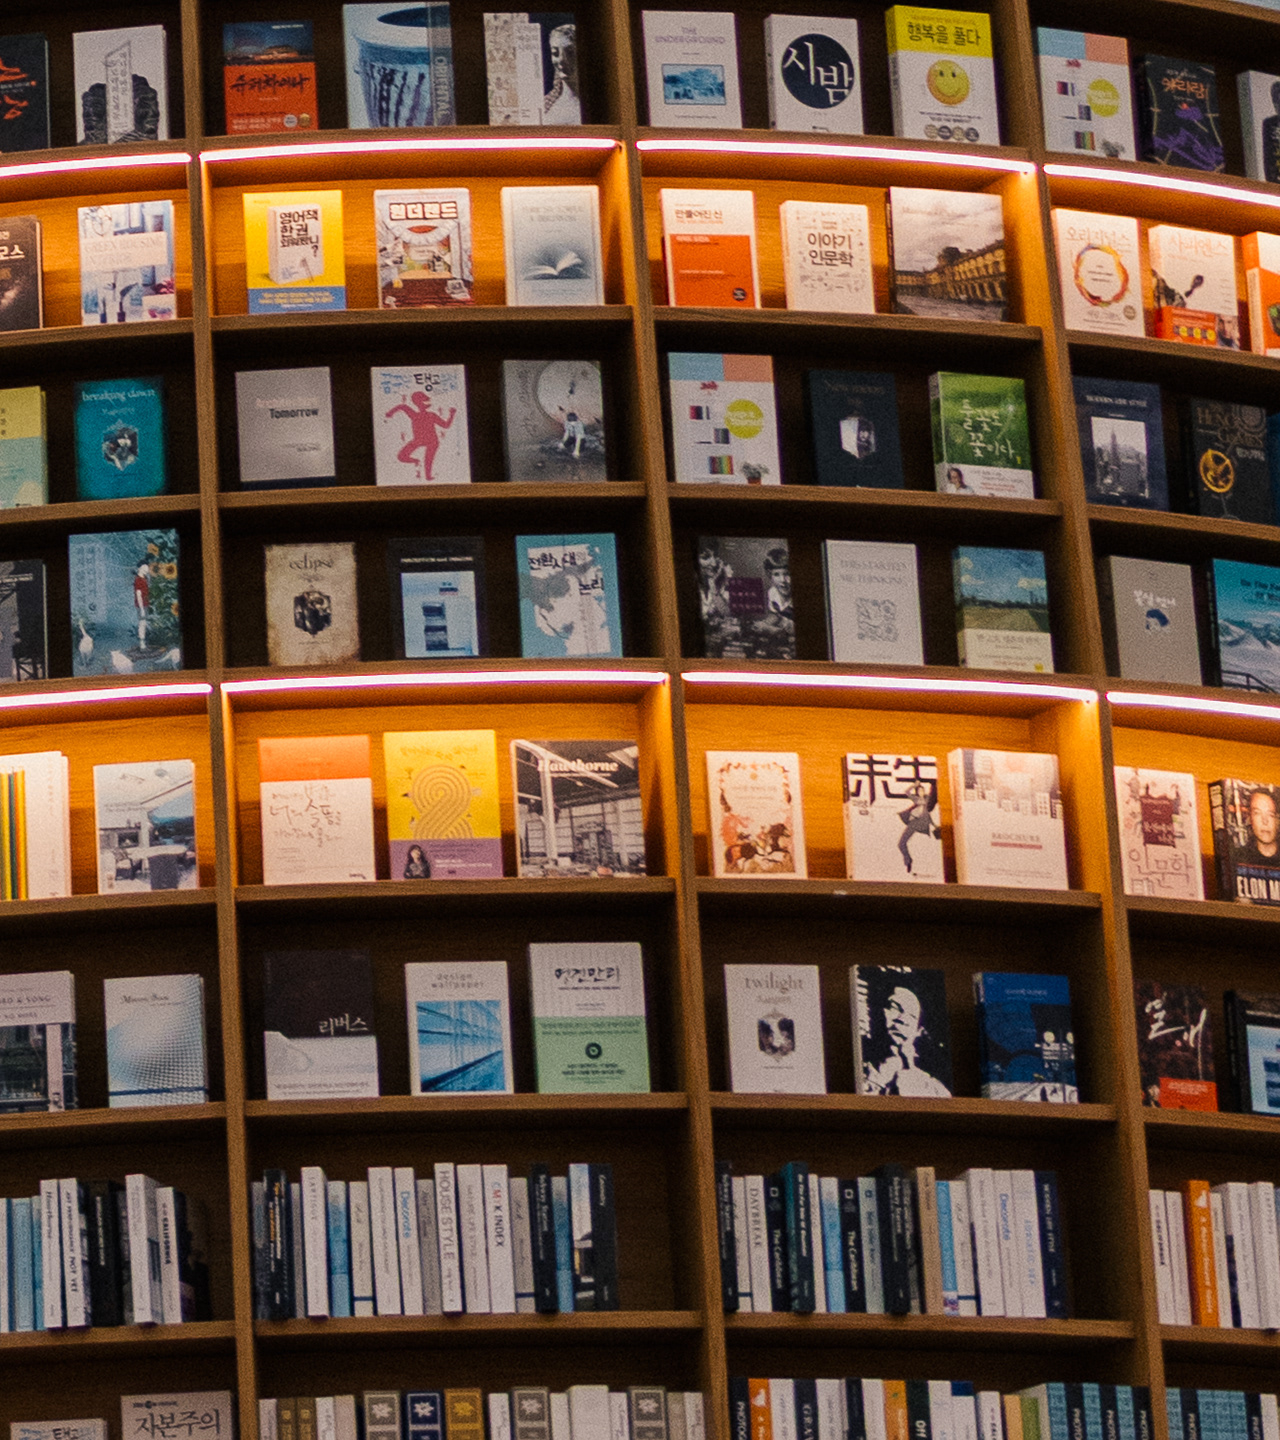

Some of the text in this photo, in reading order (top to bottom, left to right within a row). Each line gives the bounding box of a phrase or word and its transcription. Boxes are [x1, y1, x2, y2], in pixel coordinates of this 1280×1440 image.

[782, 37, 854, 105] 시밤
[387, 201, 460, 222] 원더랜드
[806, 231, 854, 252] 이야기
[807, 249, 855, 269] 인문학
[269, 406, 320, 421] Tomorrow
[744, 972, 804, 995] twilight
[319, 1012, 369, 1035] 리버스
[133, 1407, 221, 1439] 자본주의
